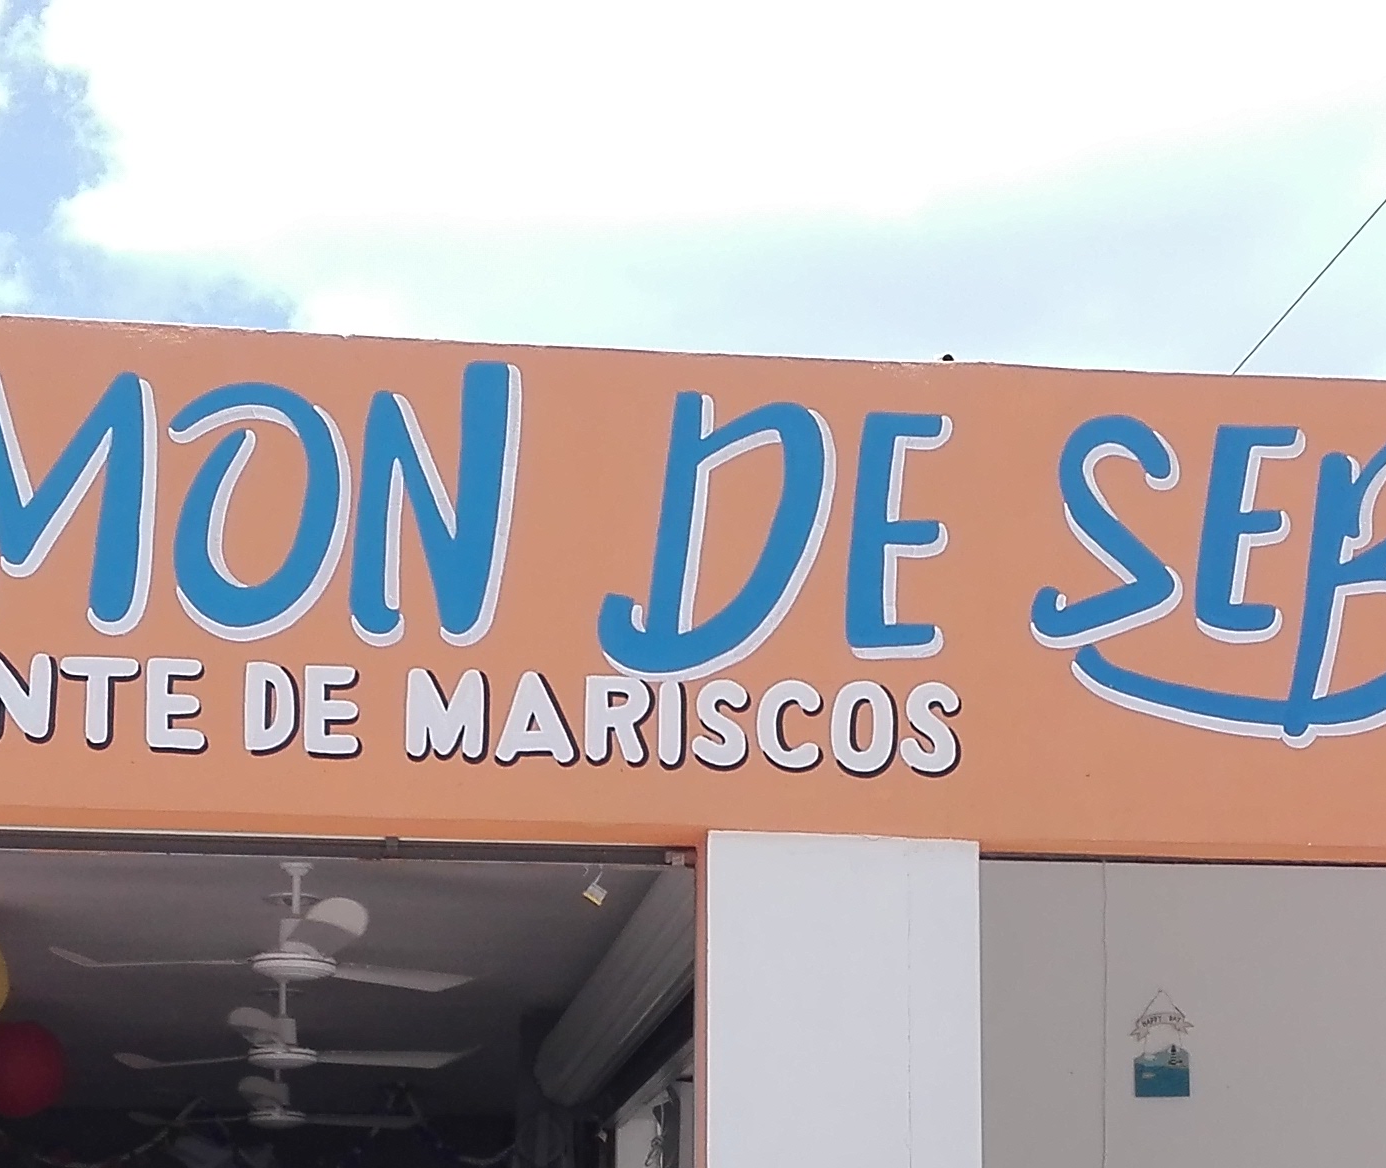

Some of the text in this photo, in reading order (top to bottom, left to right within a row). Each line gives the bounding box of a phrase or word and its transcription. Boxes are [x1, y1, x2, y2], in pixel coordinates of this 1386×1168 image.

[597, 391, 953, 682] DE
[243, 660, 363, 758] DE
[405, 668, 963, 778] MARISCOS
[1141, 1015, 1162, 1028] HAPPY
